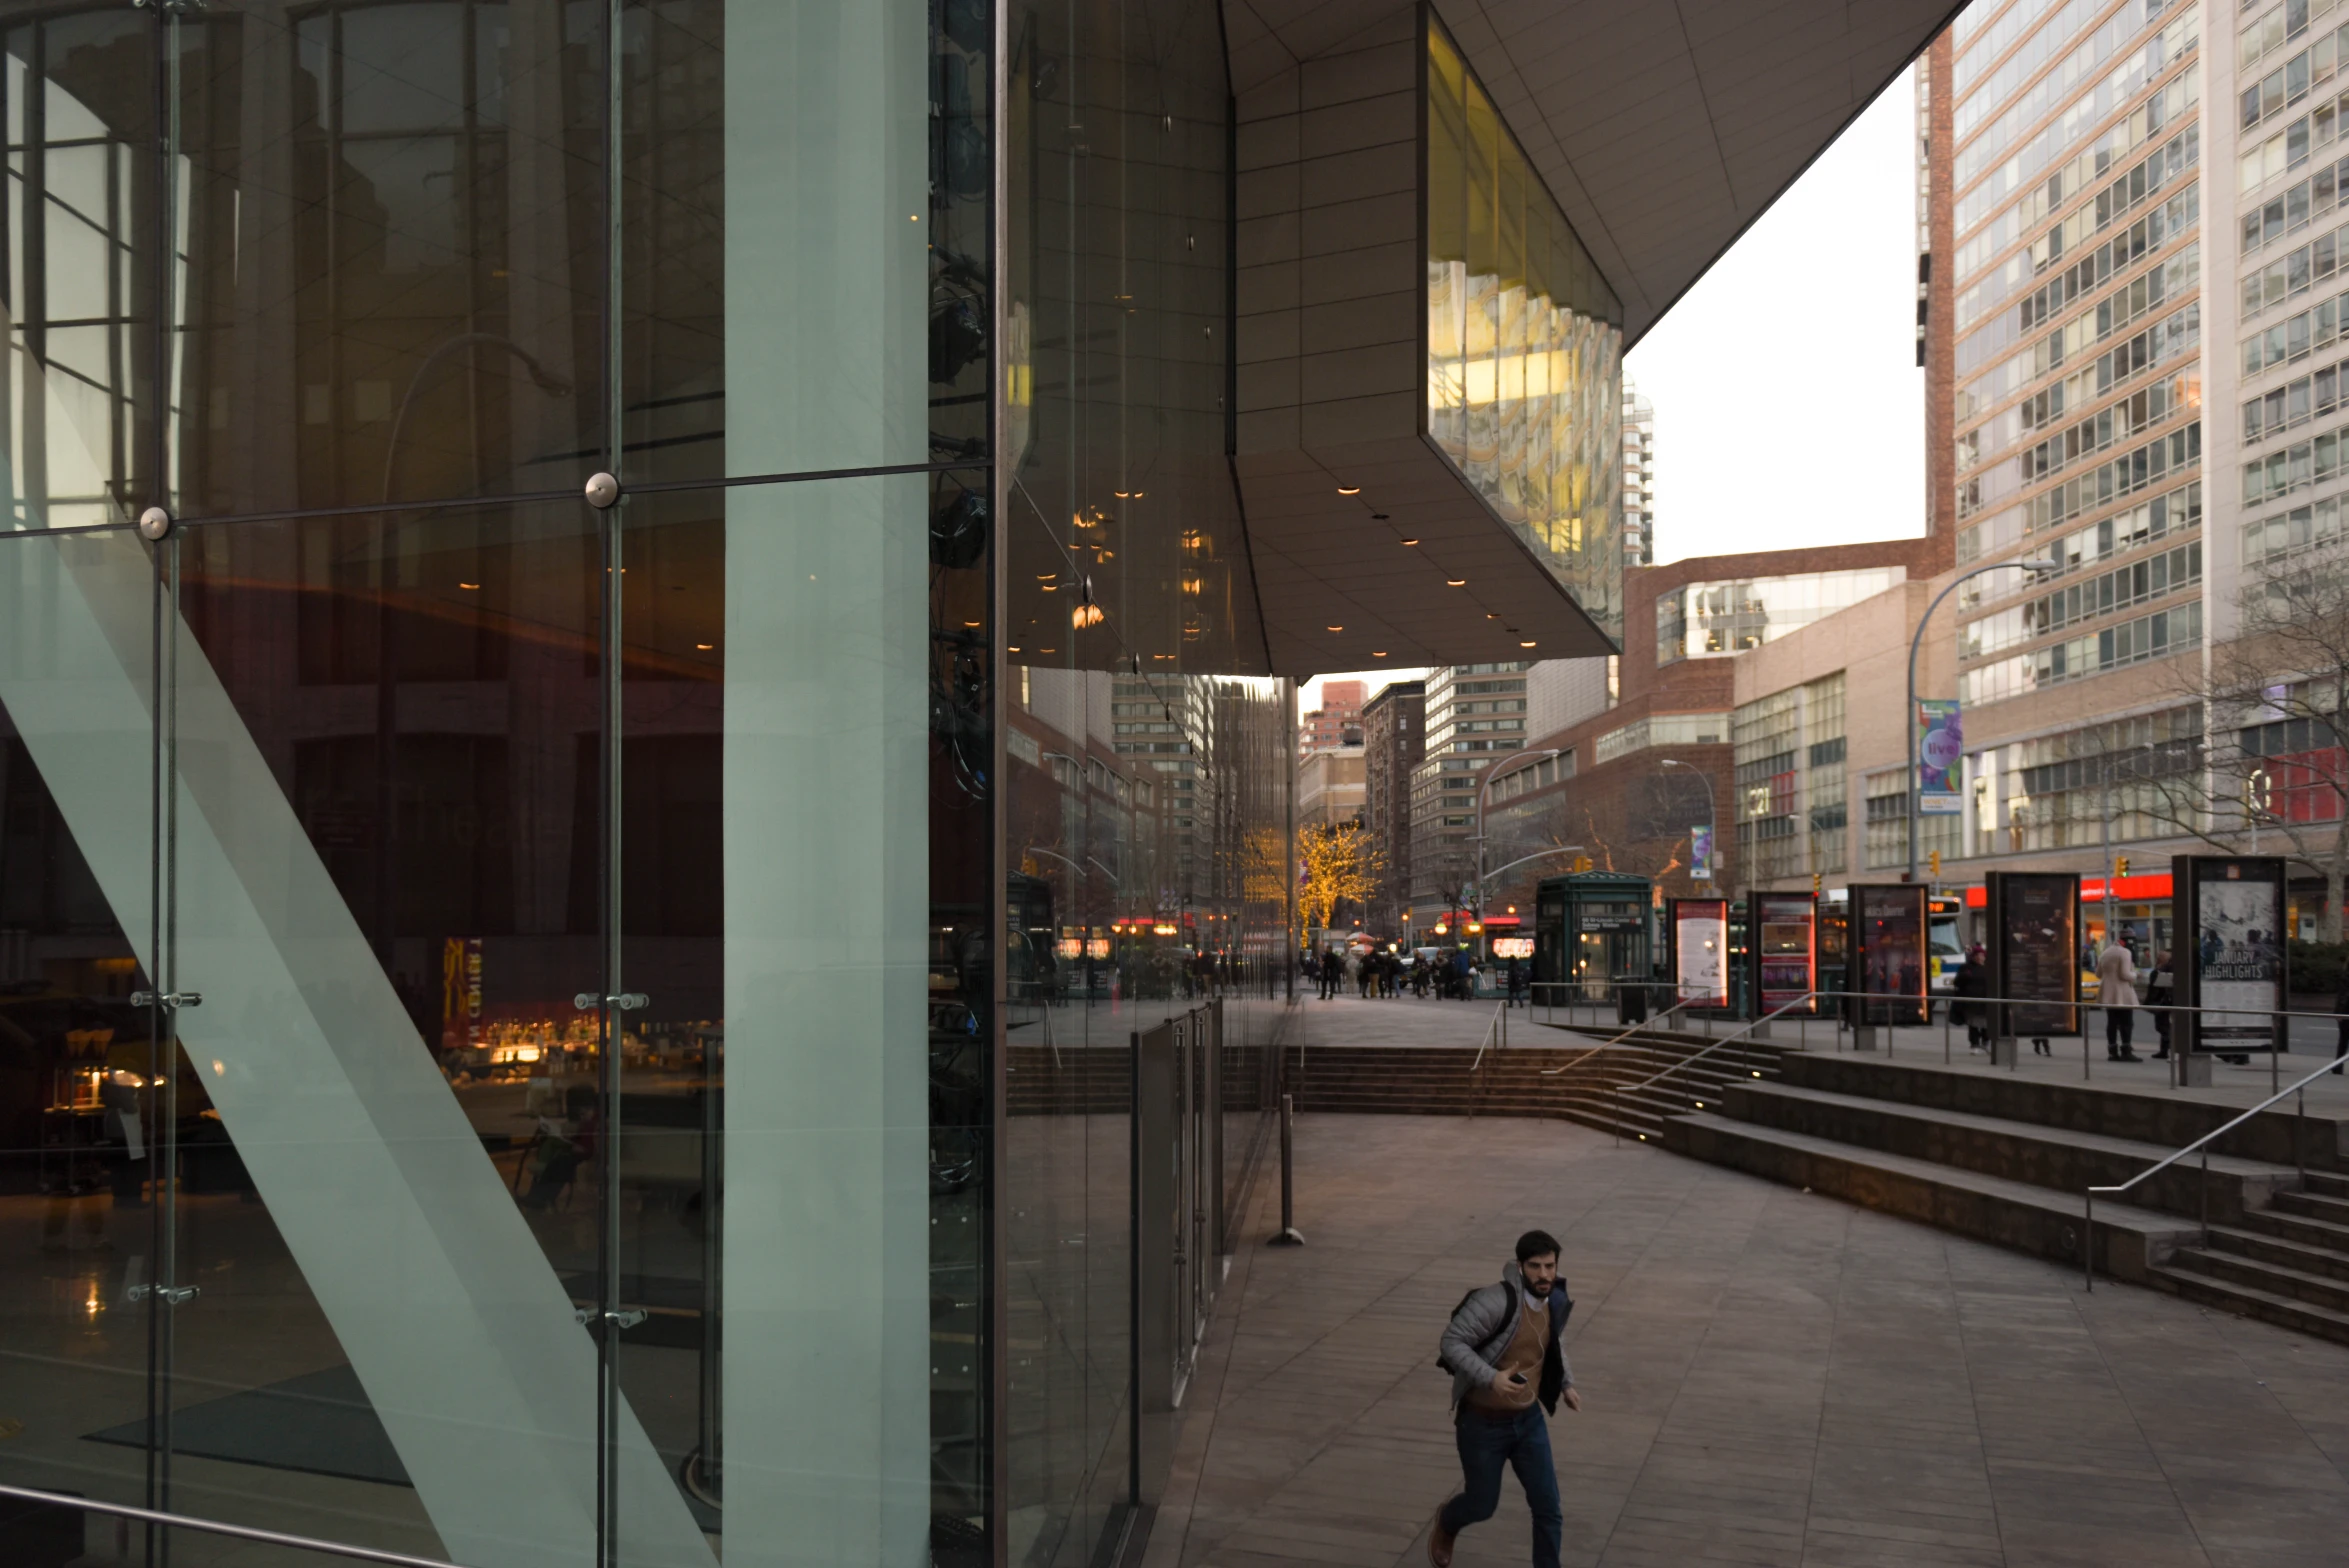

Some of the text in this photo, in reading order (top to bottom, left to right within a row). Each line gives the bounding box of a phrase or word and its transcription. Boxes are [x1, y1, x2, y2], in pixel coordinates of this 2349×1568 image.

[1928, 743, 1955, 755] live
[2213, 951, 2256, 965] JANUARY
[2205, 965, 2264, 979] HIGHLIGHTS
